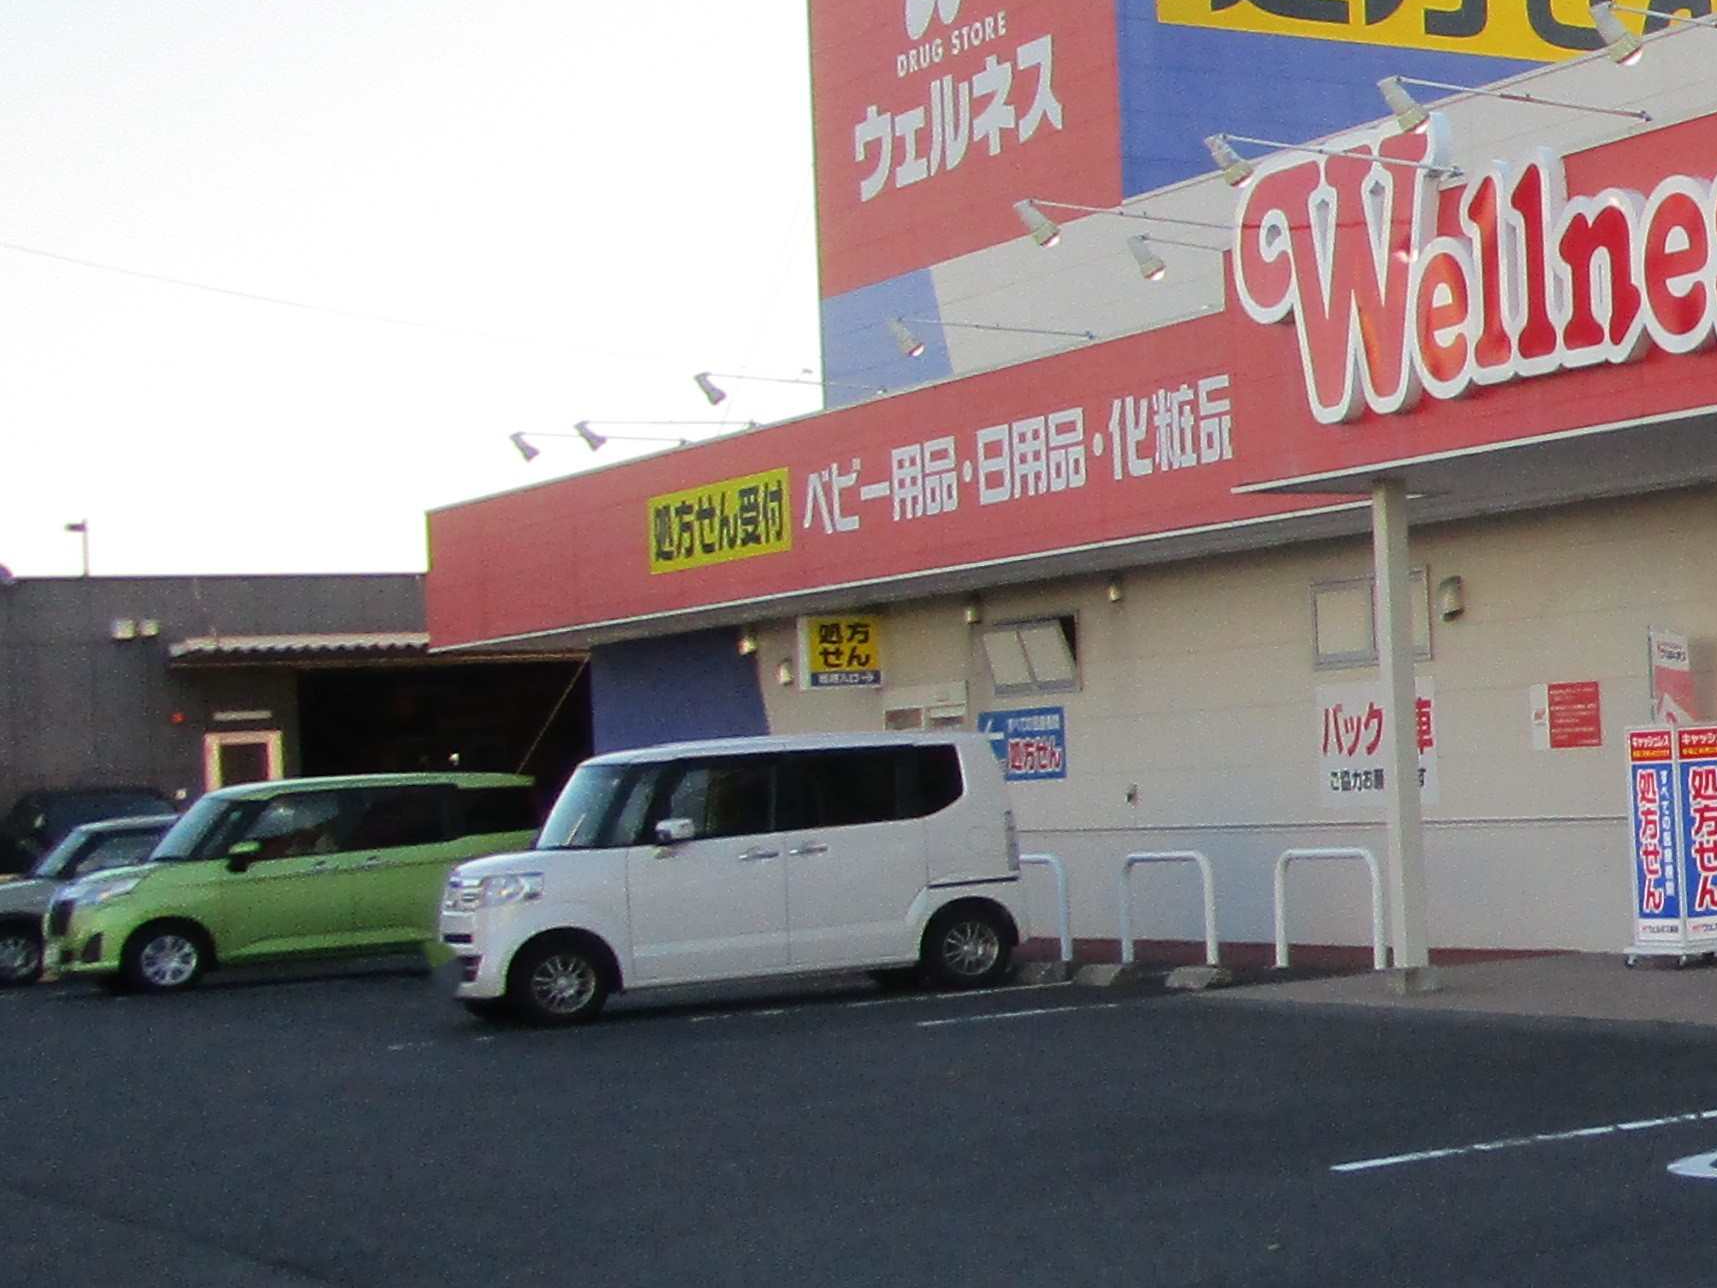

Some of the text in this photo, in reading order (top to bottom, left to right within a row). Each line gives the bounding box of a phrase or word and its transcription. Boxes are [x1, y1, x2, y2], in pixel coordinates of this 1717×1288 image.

[896, 10, 1007, 78] DRUG STORE
[855, 34, 1063, 202] ウェルネス
[655, 479, 783, 561] 処方せん受付
[819, 622, 870, 644] 処方
[819, 647, 870, 669] せん
[1637, 769, 1663, 913] 処方せん
